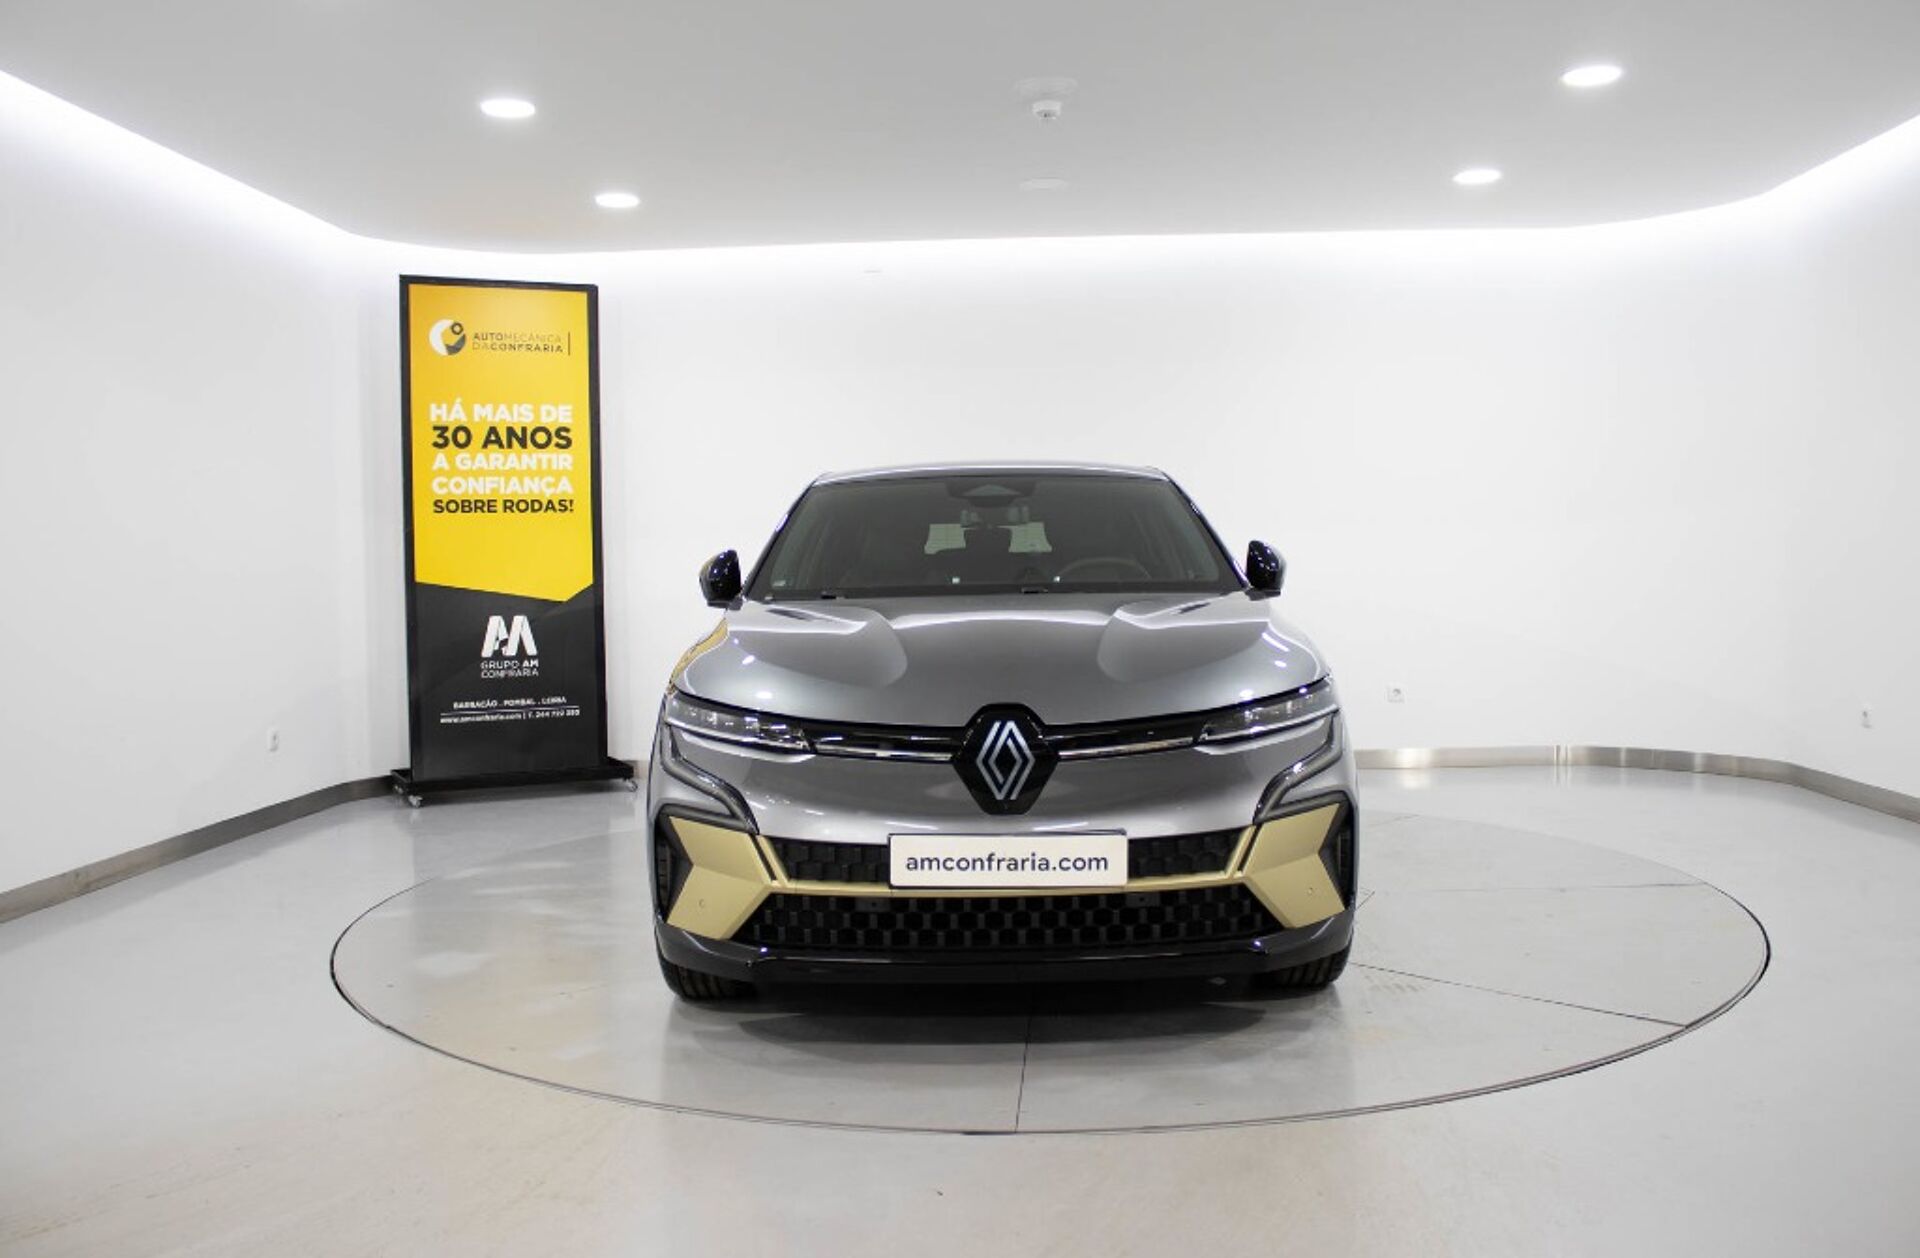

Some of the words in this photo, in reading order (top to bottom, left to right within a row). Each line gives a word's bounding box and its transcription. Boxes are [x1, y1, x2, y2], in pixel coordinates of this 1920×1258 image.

[430, 397, 467, 422] HÁ
[473, 404, 534, 423] MAIS
[540, 405, 573, 423] DE
[432, 426, 472, 449] 30
[482, 426, 572, 449] ANOS
[432, 453, 450, 470] A
[455, 452, 573, 470] GARANTIR
[431, 476, 574, 497] CONFIANÇA
[433, 499, 497, 513] SOBRE
[503, 499, 574, 513] RODAS!
[480, 660, 519, 669] GRUPO
[522, 659, 539, 668] AM
[906, 852, 1108, 871] amconfraria.com
